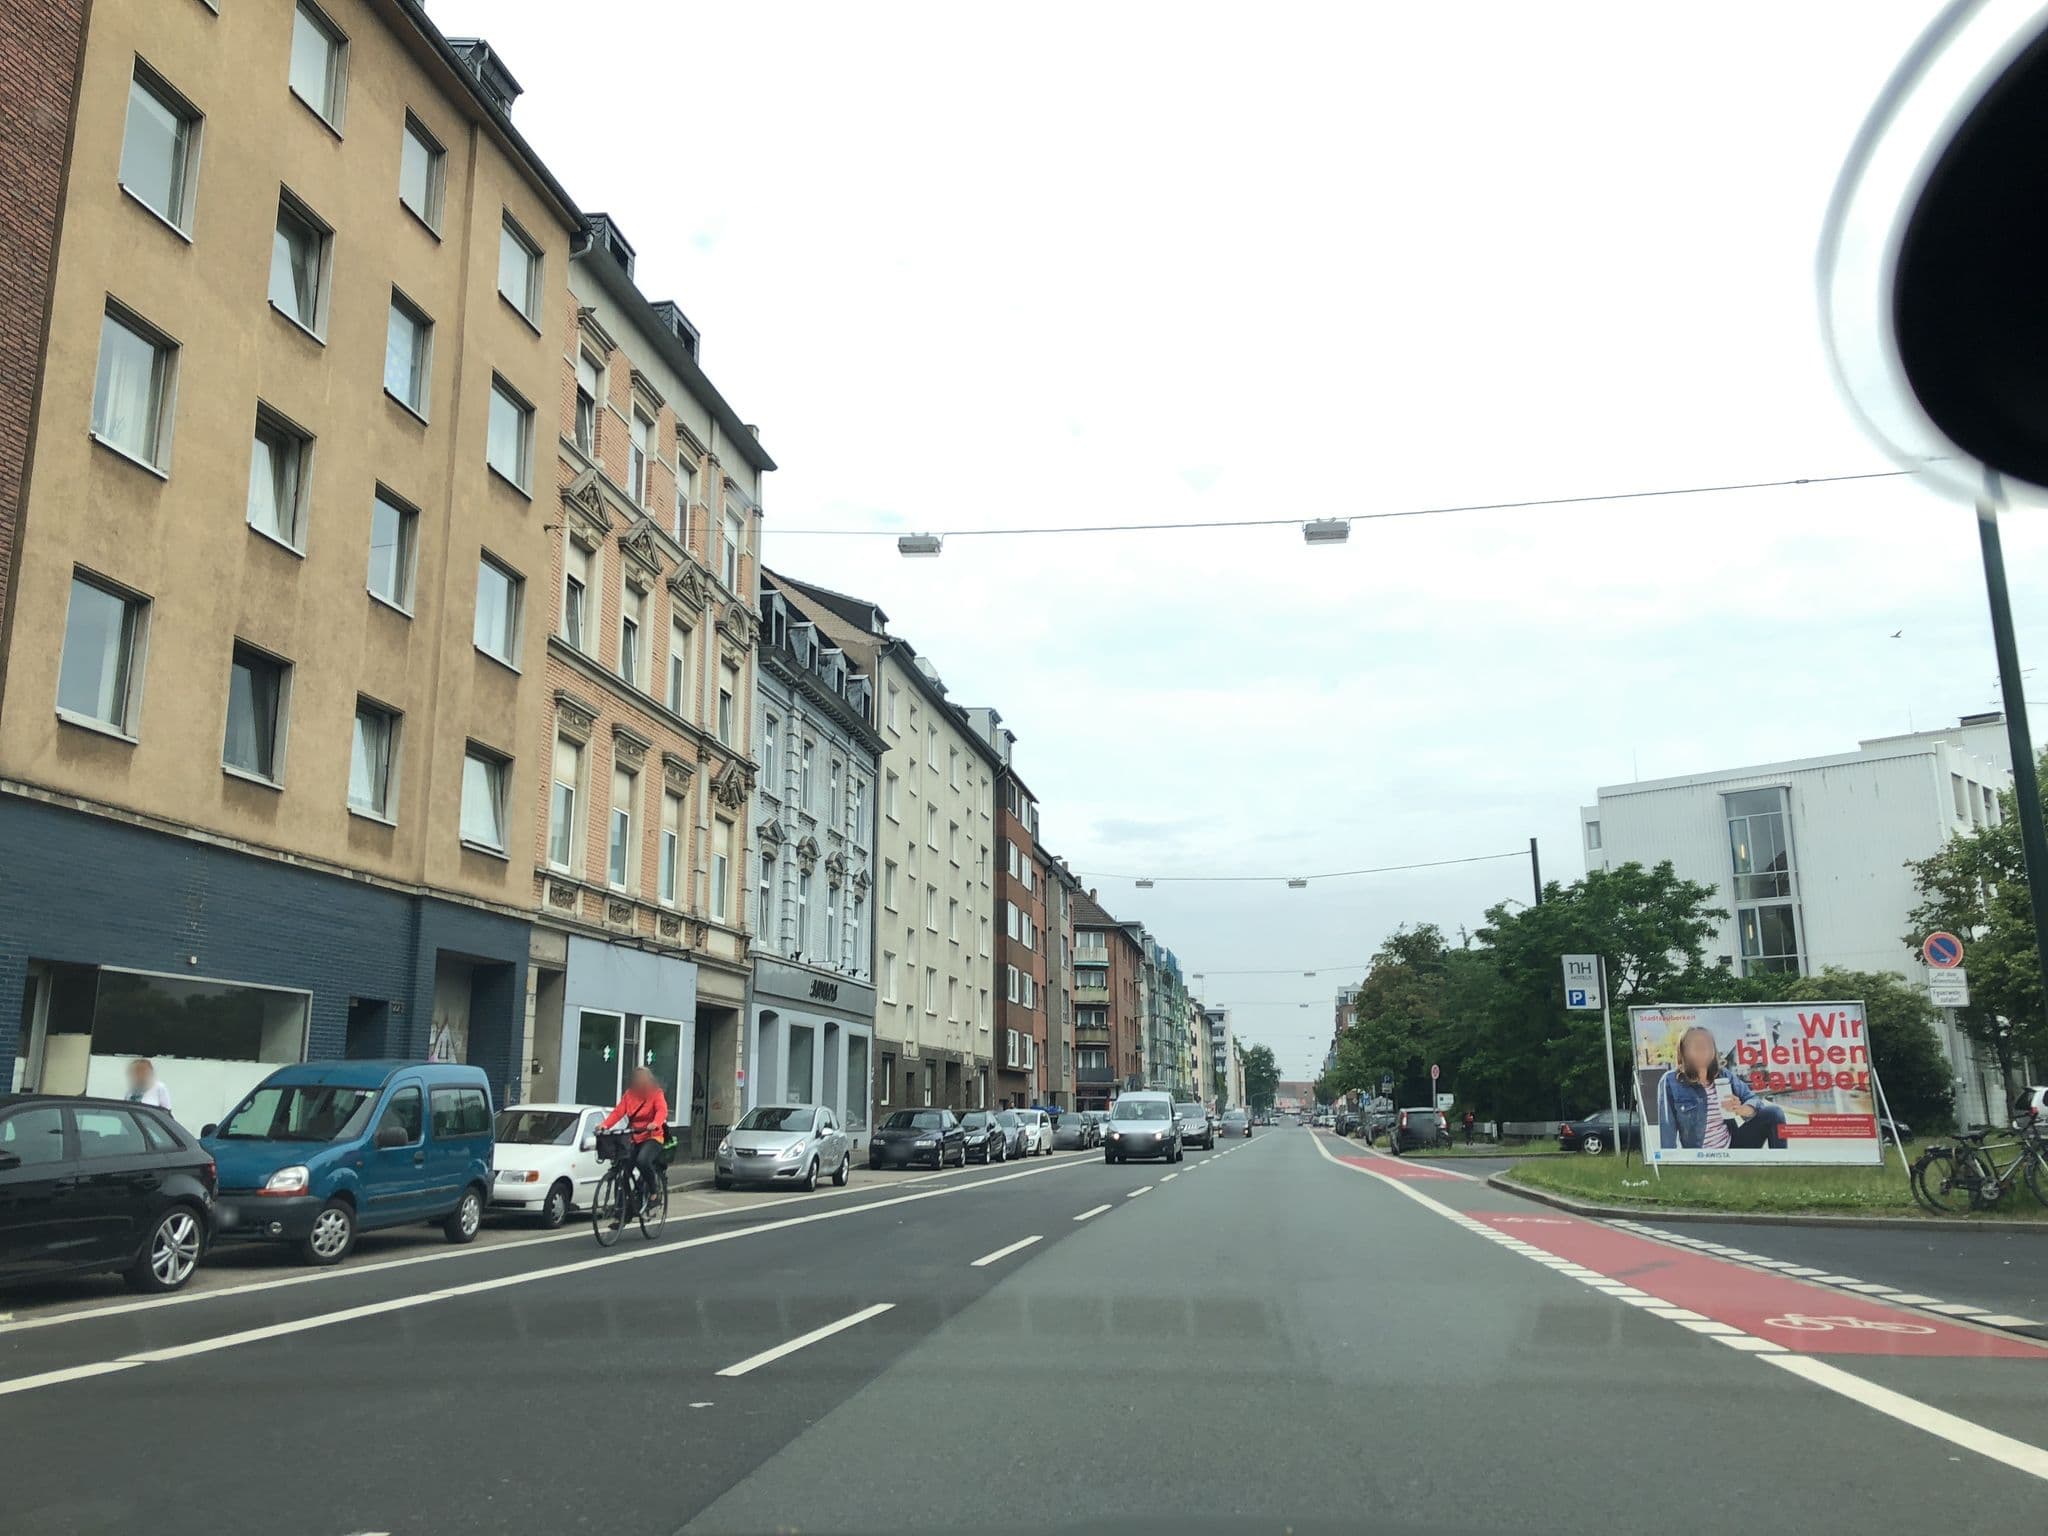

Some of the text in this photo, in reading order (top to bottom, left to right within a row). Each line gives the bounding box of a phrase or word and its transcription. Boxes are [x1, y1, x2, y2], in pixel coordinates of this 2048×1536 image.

[1572, 991, 1583, 1004] P
[1797, 1011, 1863, 1038] Wir
[1736, 1038, 1868, 1065] bleiben
[1749, 1062, 1871, 1092] sauber
